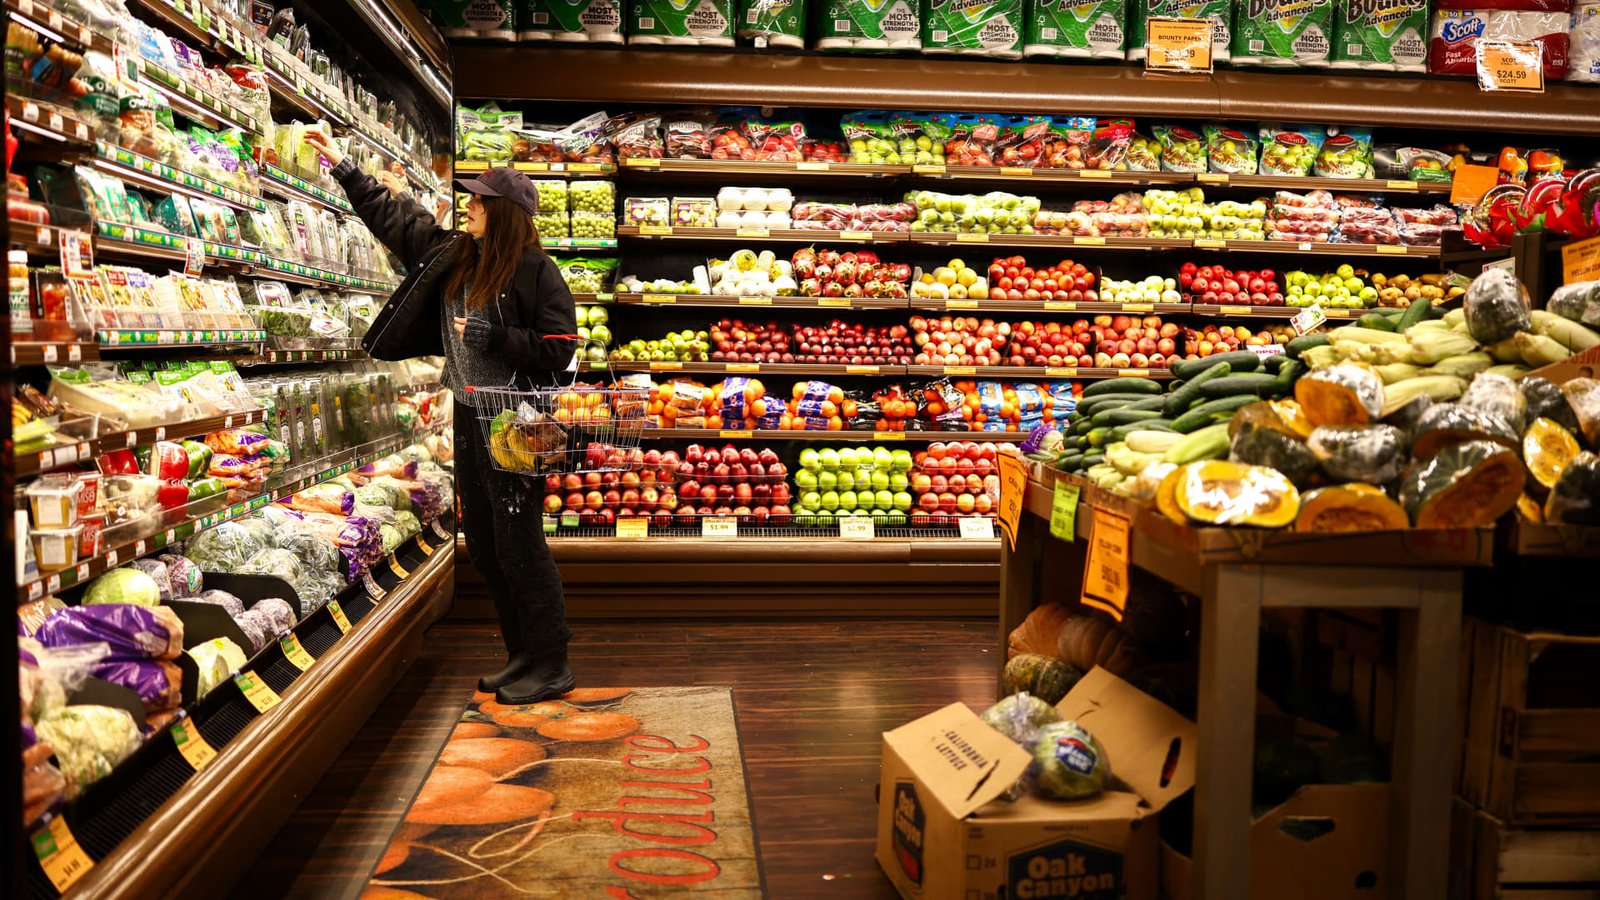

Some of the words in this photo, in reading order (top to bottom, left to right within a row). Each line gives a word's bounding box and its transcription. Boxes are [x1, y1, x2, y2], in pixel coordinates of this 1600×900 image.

[694, 11, 718, 19] MOST
[1266, 3, 1313, 22] Advanced
[1364, 7, 1412, 27] Advanced
[986, 24, 1010, 33] MOST
[1094, 24, 1118, 32] MOST
[1447, 17, 1480, 41] Scott
[1300, 35, 1324, 43] MOST
[1496, 69, 1527, 79] $24.59
[935, 743, 967, 771] LETTUCE
[945, 730, 989, 770] CALIFORNIA
[573, 734, 721, 900] oduce
[1027, 852, 1087, 879] Oak
[1016, 873, 1114, 900] Canyon
